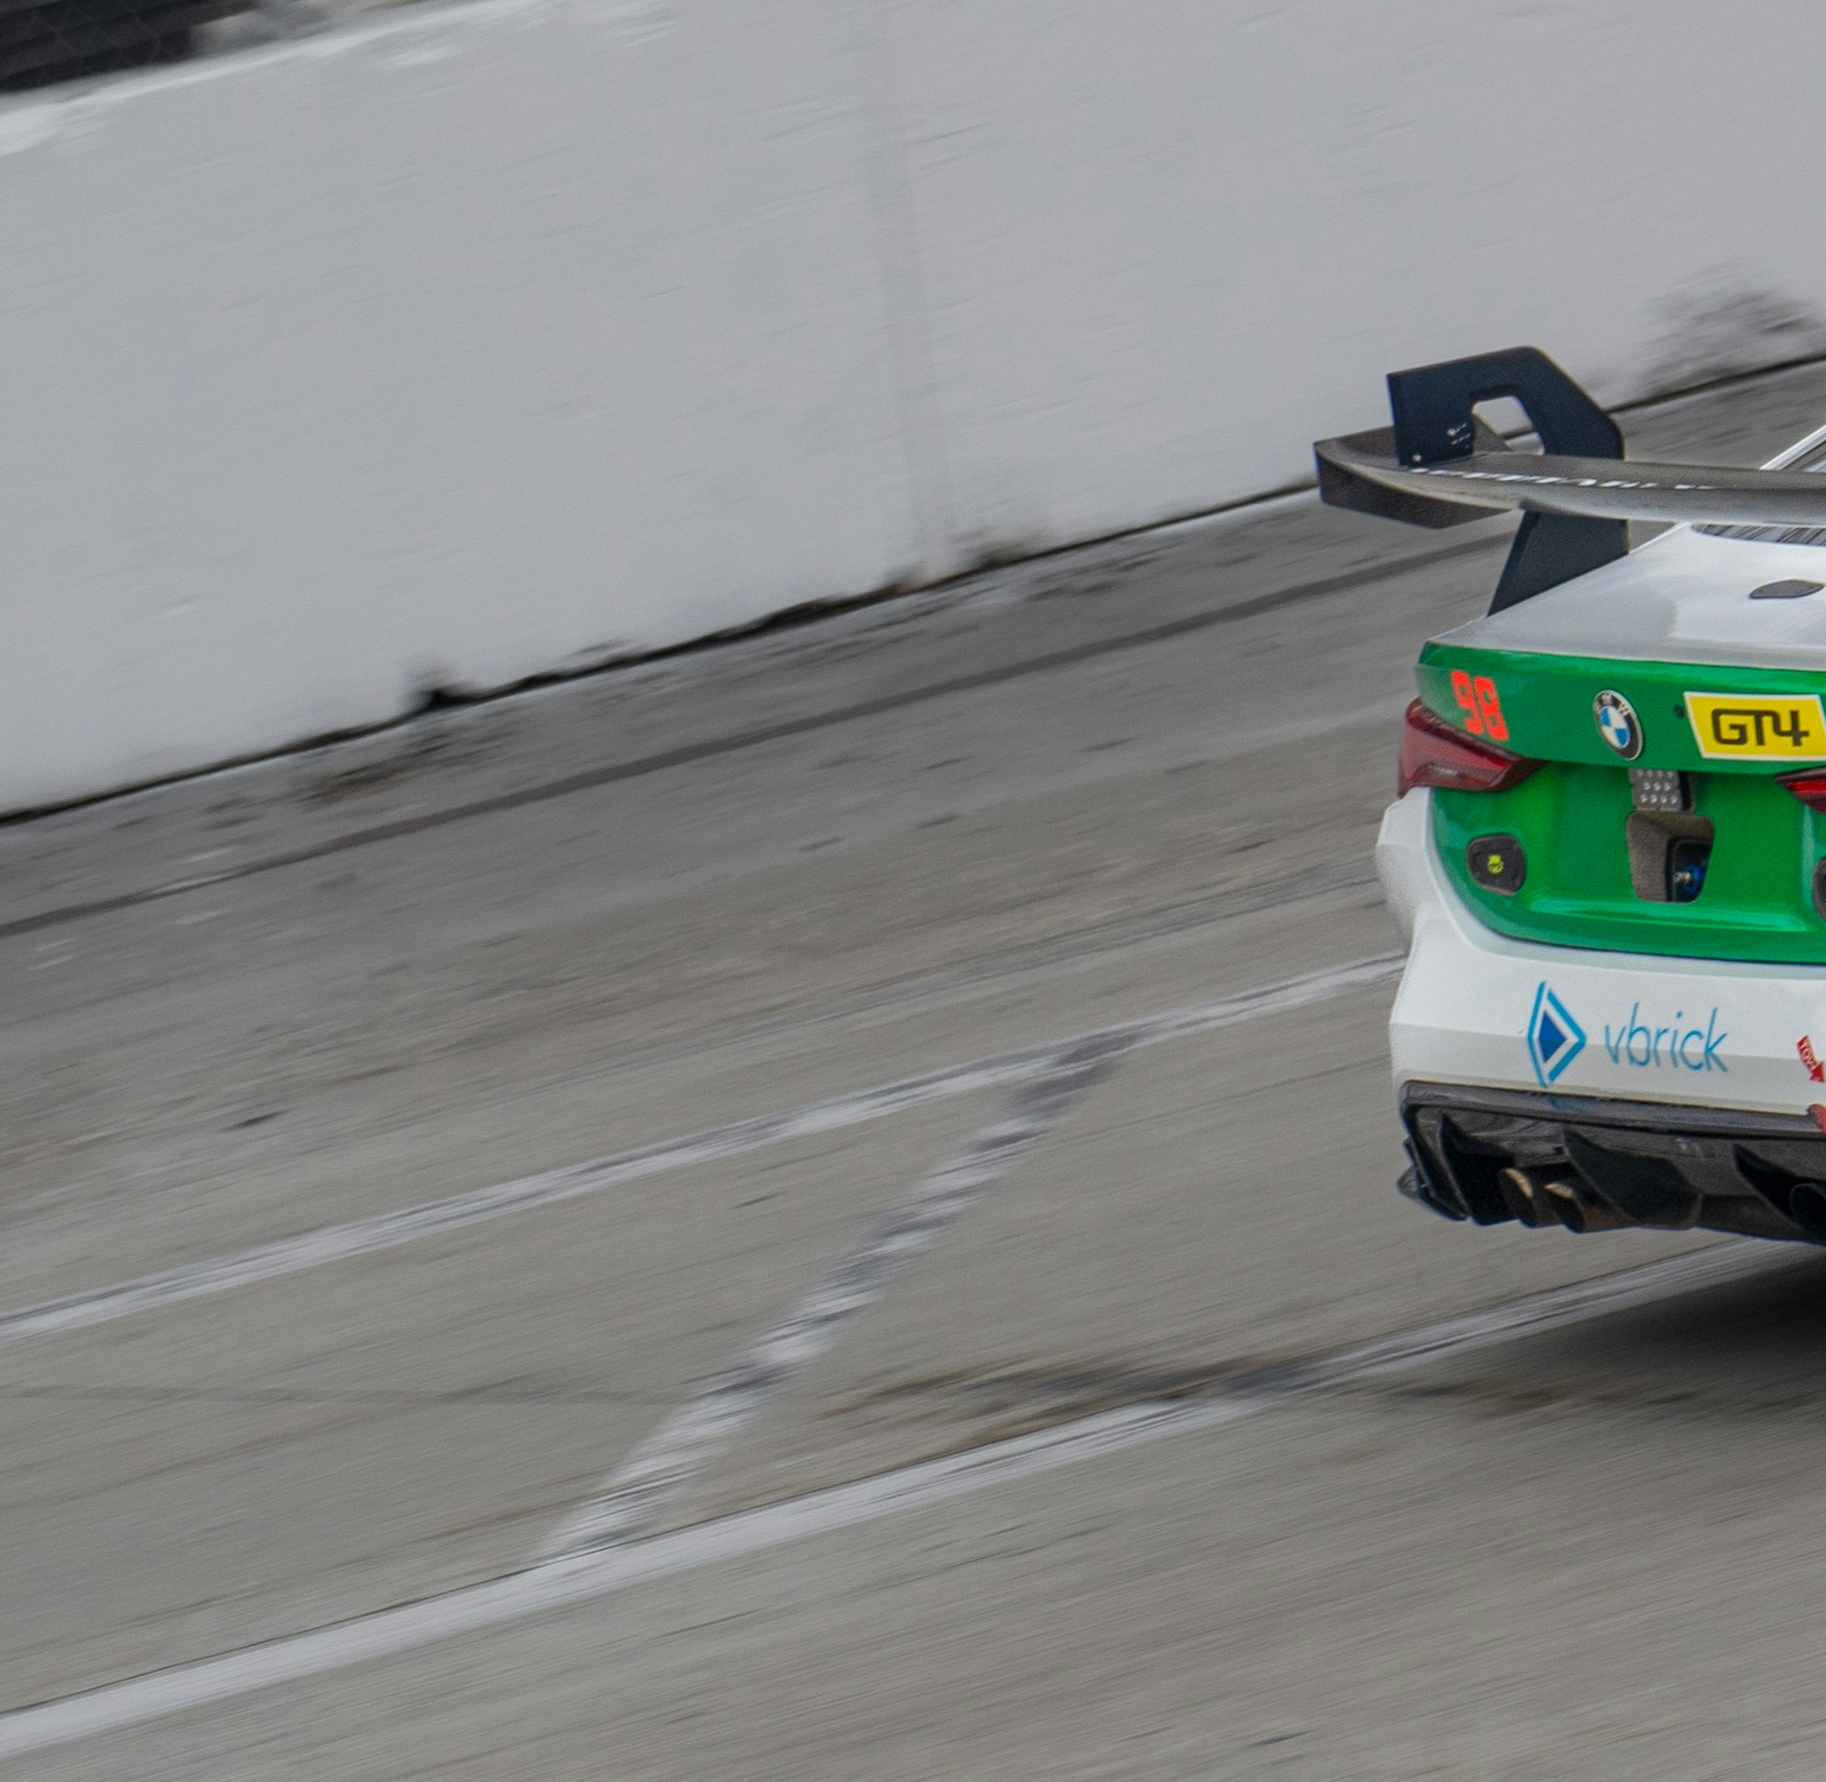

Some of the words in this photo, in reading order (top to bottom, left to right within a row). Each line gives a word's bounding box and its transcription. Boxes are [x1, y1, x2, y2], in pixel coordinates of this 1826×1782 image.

[1450, 670, 1509, 742] 98
[1711, 708, 1810, 747] GT4
[1603, 1002, 1729, 1073] vbrick
